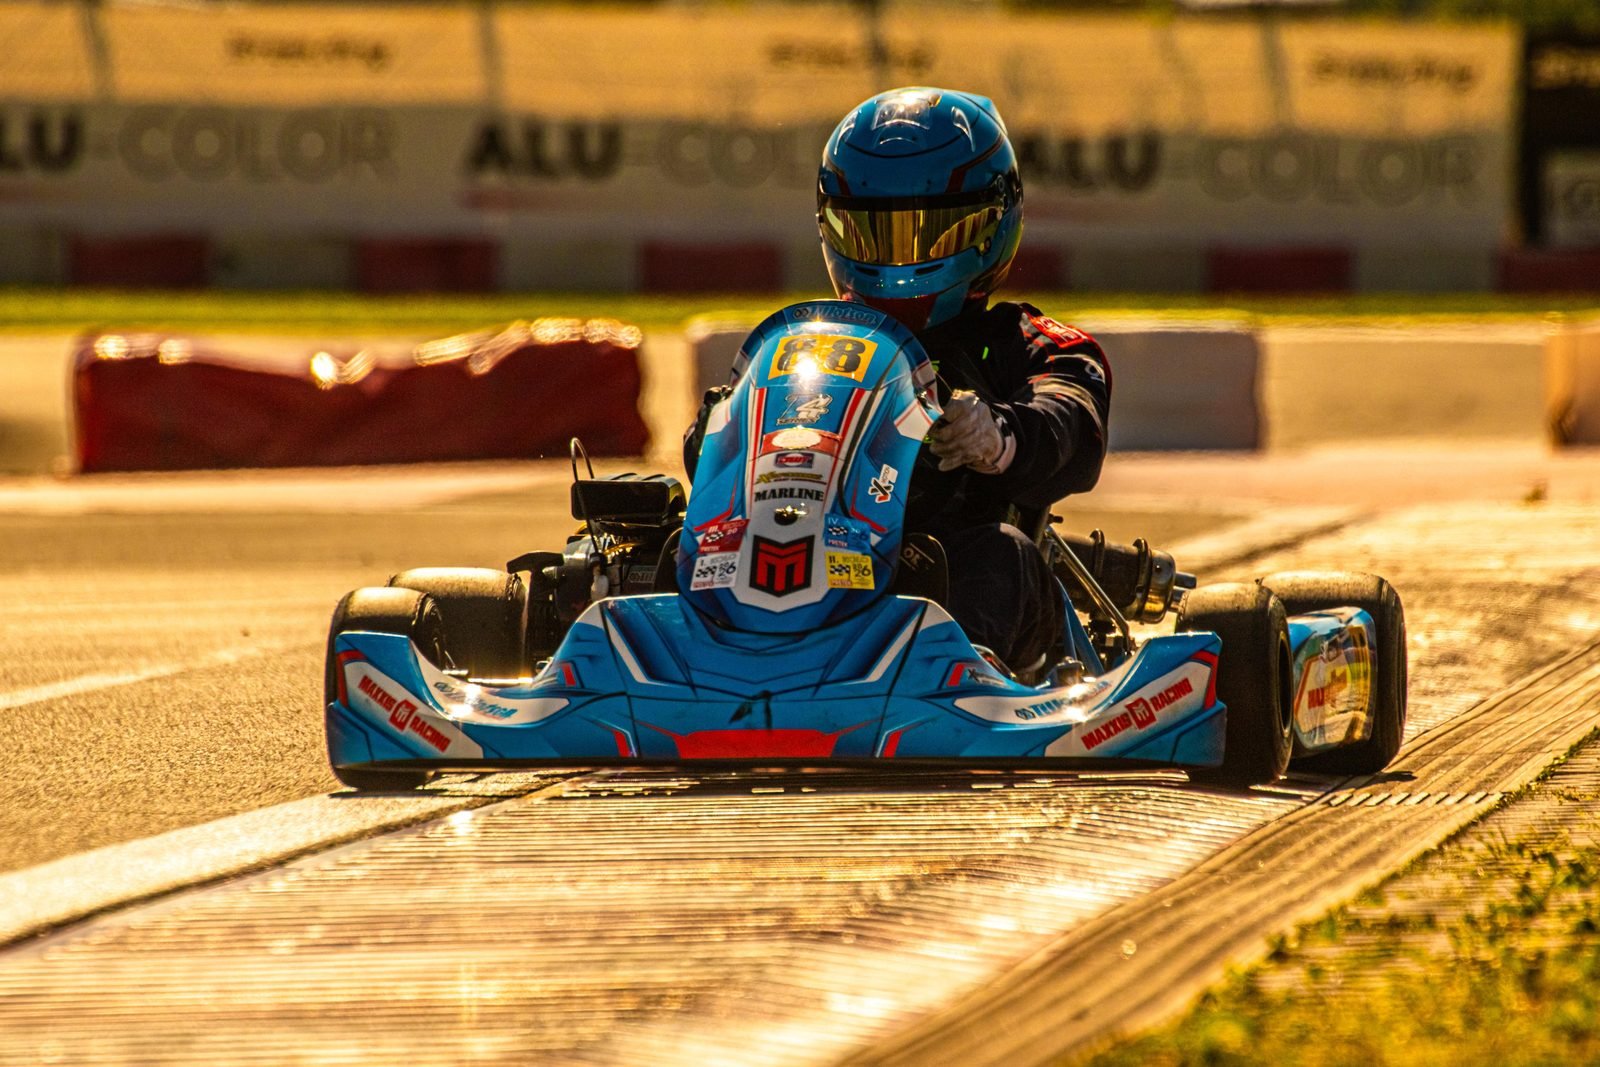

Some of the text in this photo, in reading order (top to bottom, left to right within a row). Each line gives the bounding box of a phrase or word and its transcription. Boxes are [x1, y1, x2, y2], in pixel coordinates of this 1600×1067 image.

[466, 119, 832, 188] ALU COL
[754, 487, 825, 502] MARLINE
[358, 675, 397, 713] MAXXIS
[409, 715, 452, 753] RACING
[1081, 711, 1131, 751] MAXXIS
[1150, 677, 1193, 712] RACING
